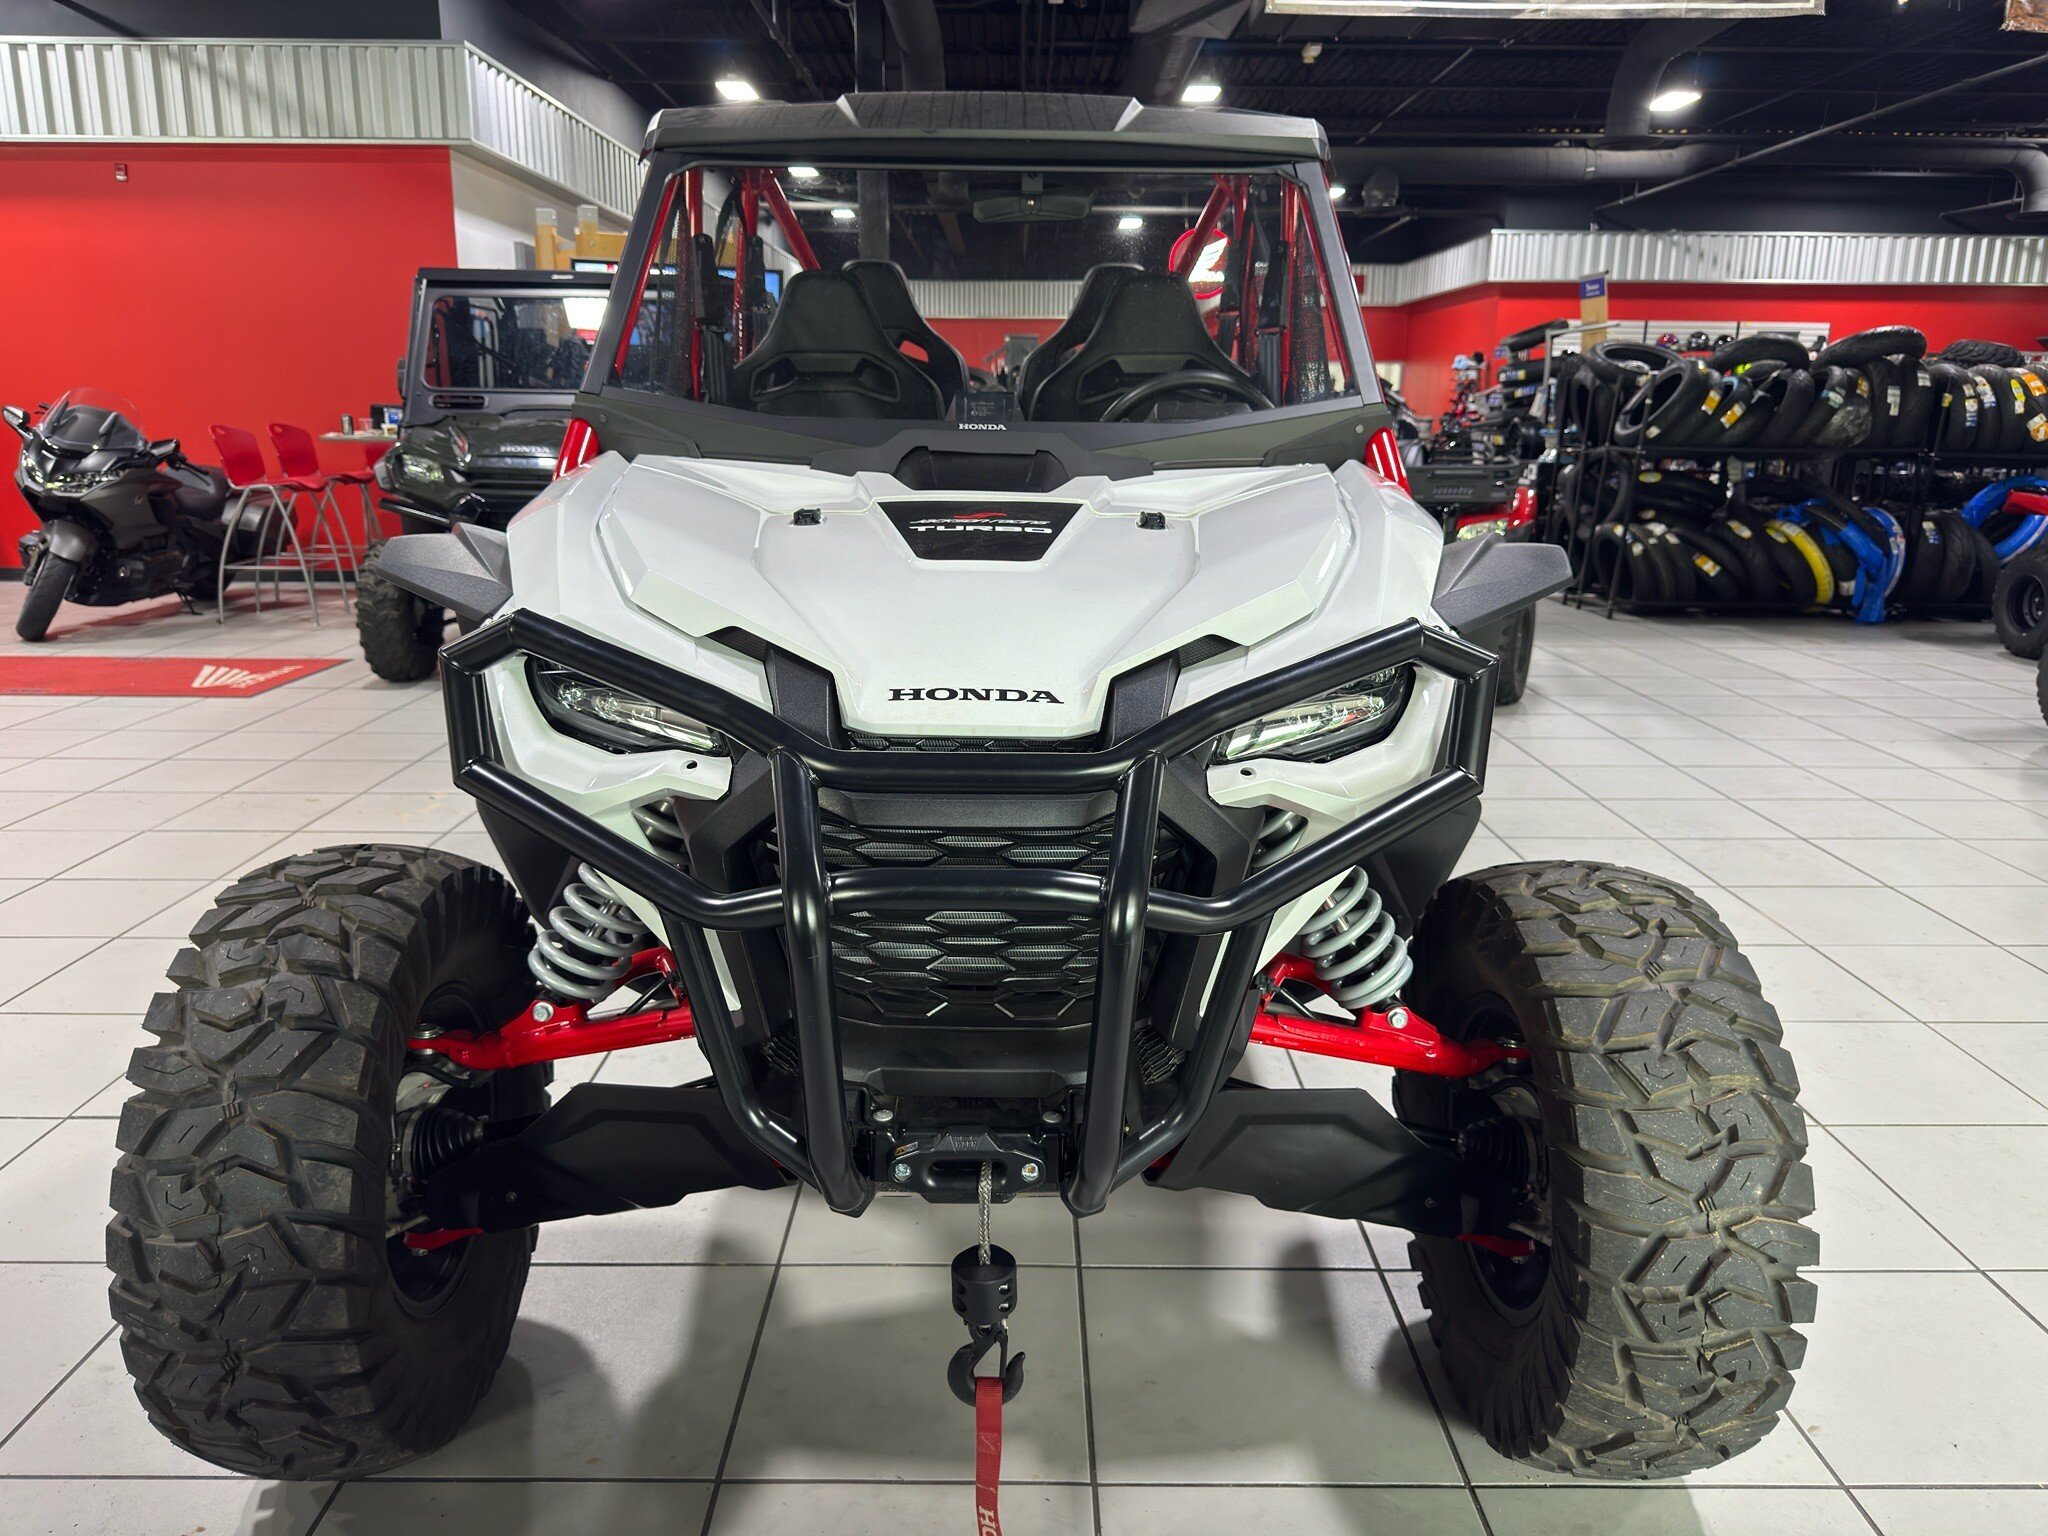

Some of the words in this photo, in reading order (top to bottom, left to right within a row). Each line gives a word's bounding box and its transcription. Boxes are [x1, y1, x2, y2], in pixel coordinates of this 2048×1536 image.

[958, 423, 1007, 431] HONDA
[908, 525, 1053, 534] TURBO
[888, 687, 1065, 705] HONDA
